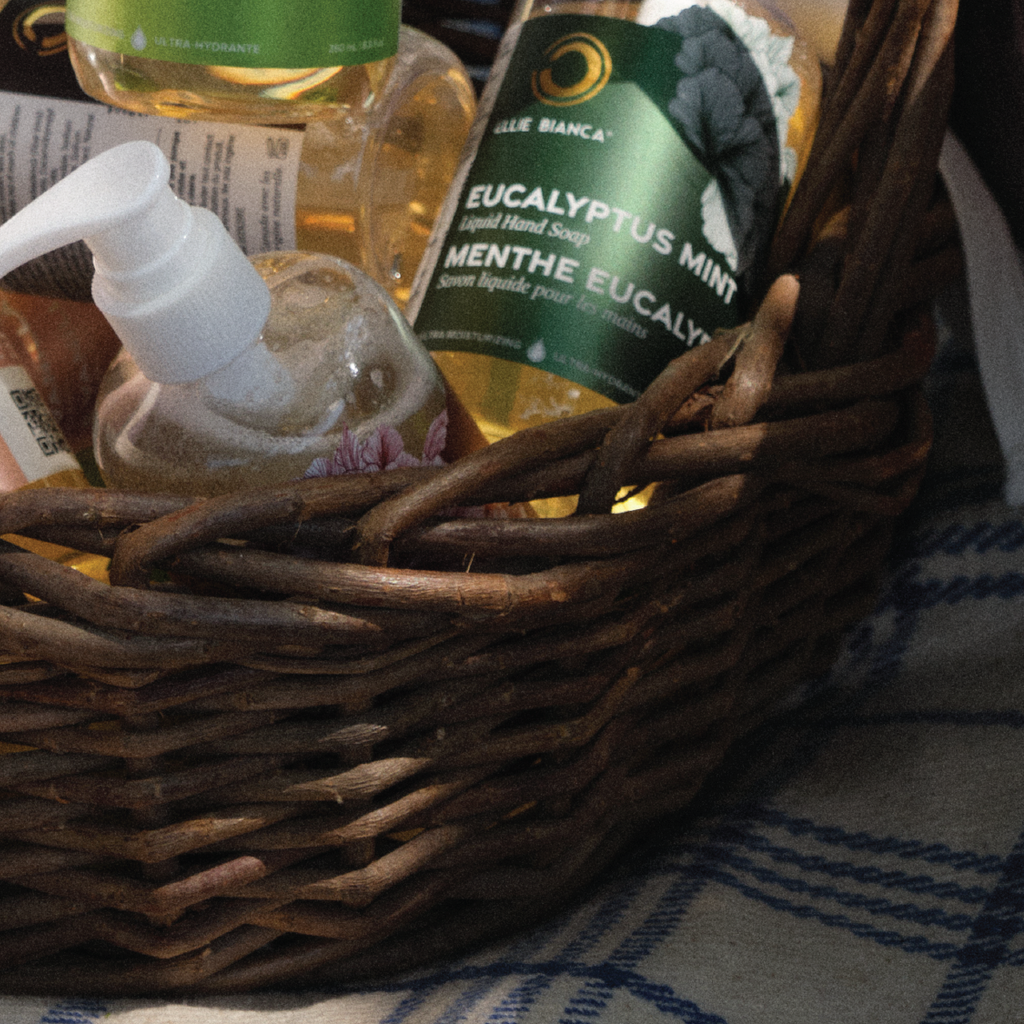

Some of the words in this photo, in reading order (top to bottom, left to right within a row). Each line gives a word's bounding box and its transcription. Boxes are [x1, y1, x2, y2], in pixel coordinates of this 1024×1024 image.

[458, 214, 501, 234] Liquid
[501, 215, 546, 236] Hand
[546, 219, 590, 249] Soap
[464, 182, 676, 256] EUCALYPTUS
[678, 241, 738, 305] MINT
[444, 244, 580, 285] MENTHE
[435, 272, 476, 291] Savon
[477, 272, 531, 295] liquide
[530, 285, 574, 305] pour
[575, 293, 597, 314] les
[601, 307, 649, 340] mains
